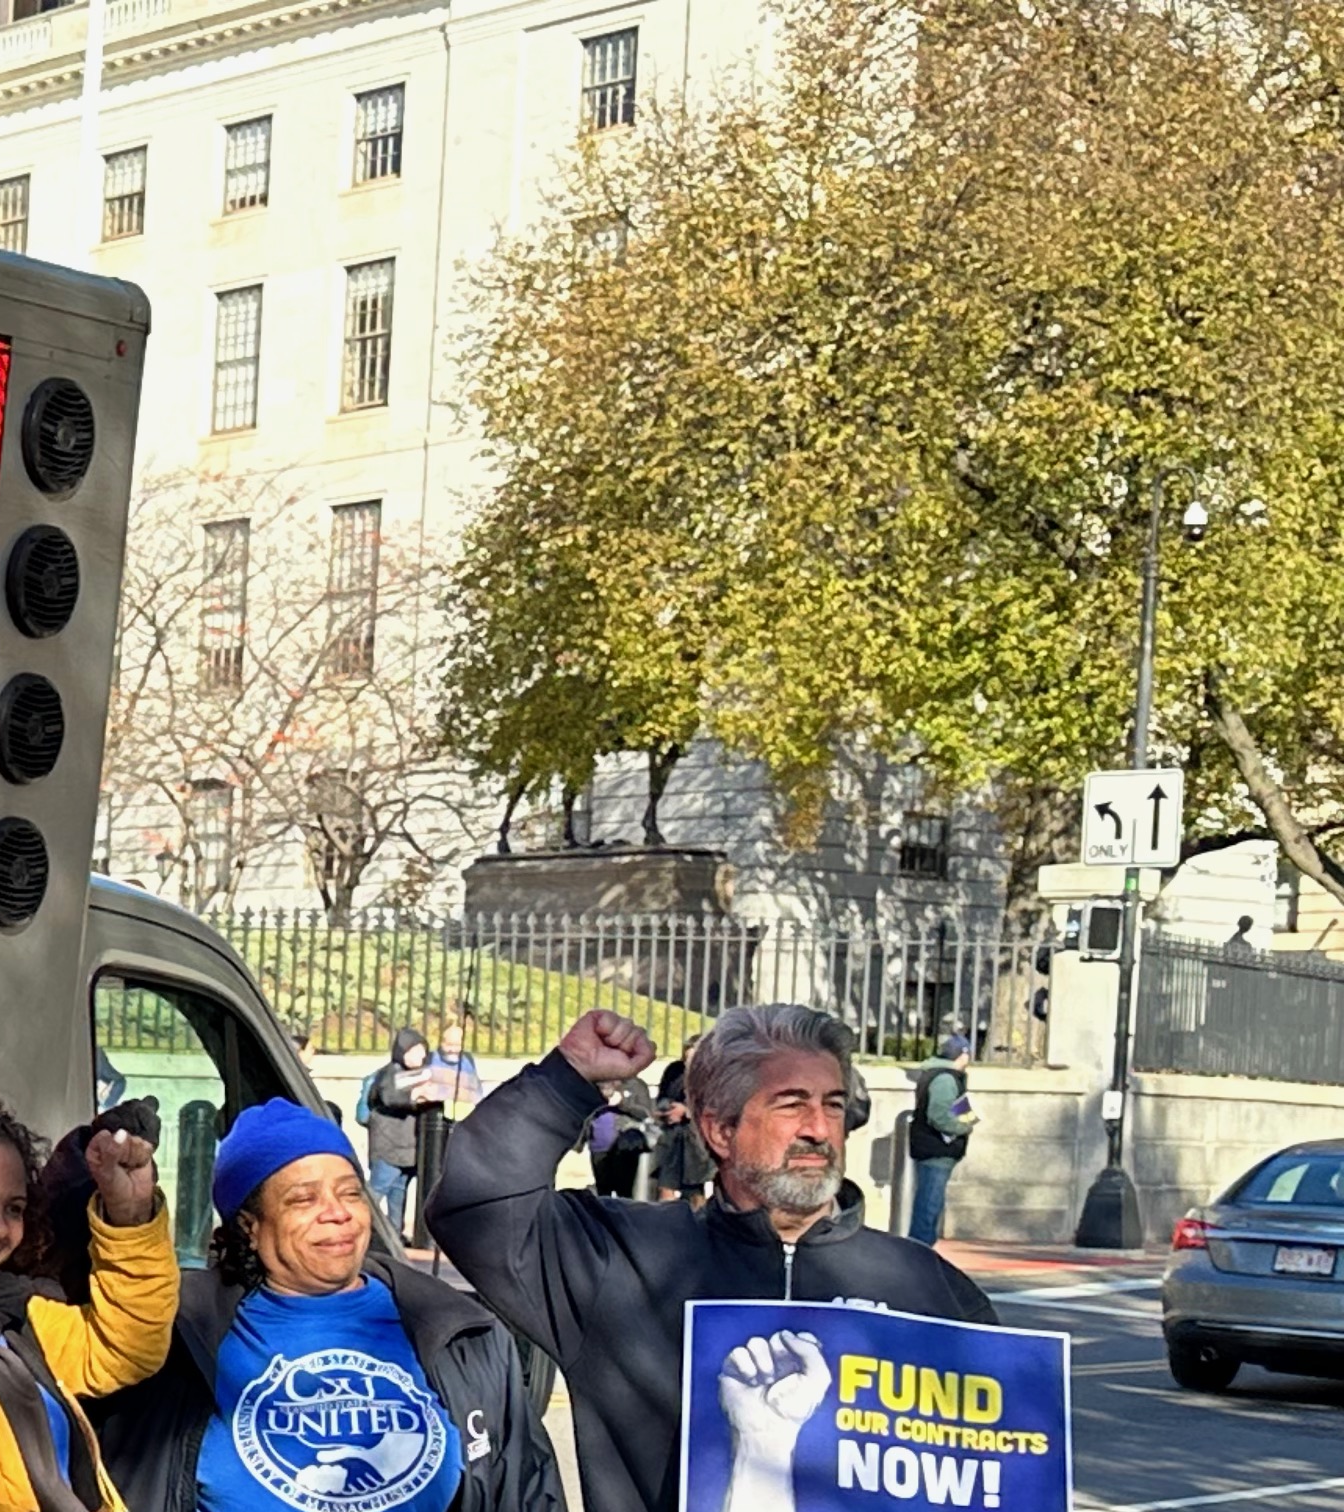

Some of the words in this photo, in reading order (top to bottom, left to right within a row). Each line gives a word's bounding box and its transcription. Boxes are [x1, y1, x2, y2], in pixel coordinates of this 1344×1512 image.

[1088, 844, 1129, 859] ONLY
[838, 1354, 1003, 1424] FUND
[266, 1403, 420, 1437] UNITED
[835, 1407, 890, 1436] OUR
[894, 1416, 1049, 1455] CONTRACTS
[837, 1438, 1002, 1509] NOW!
